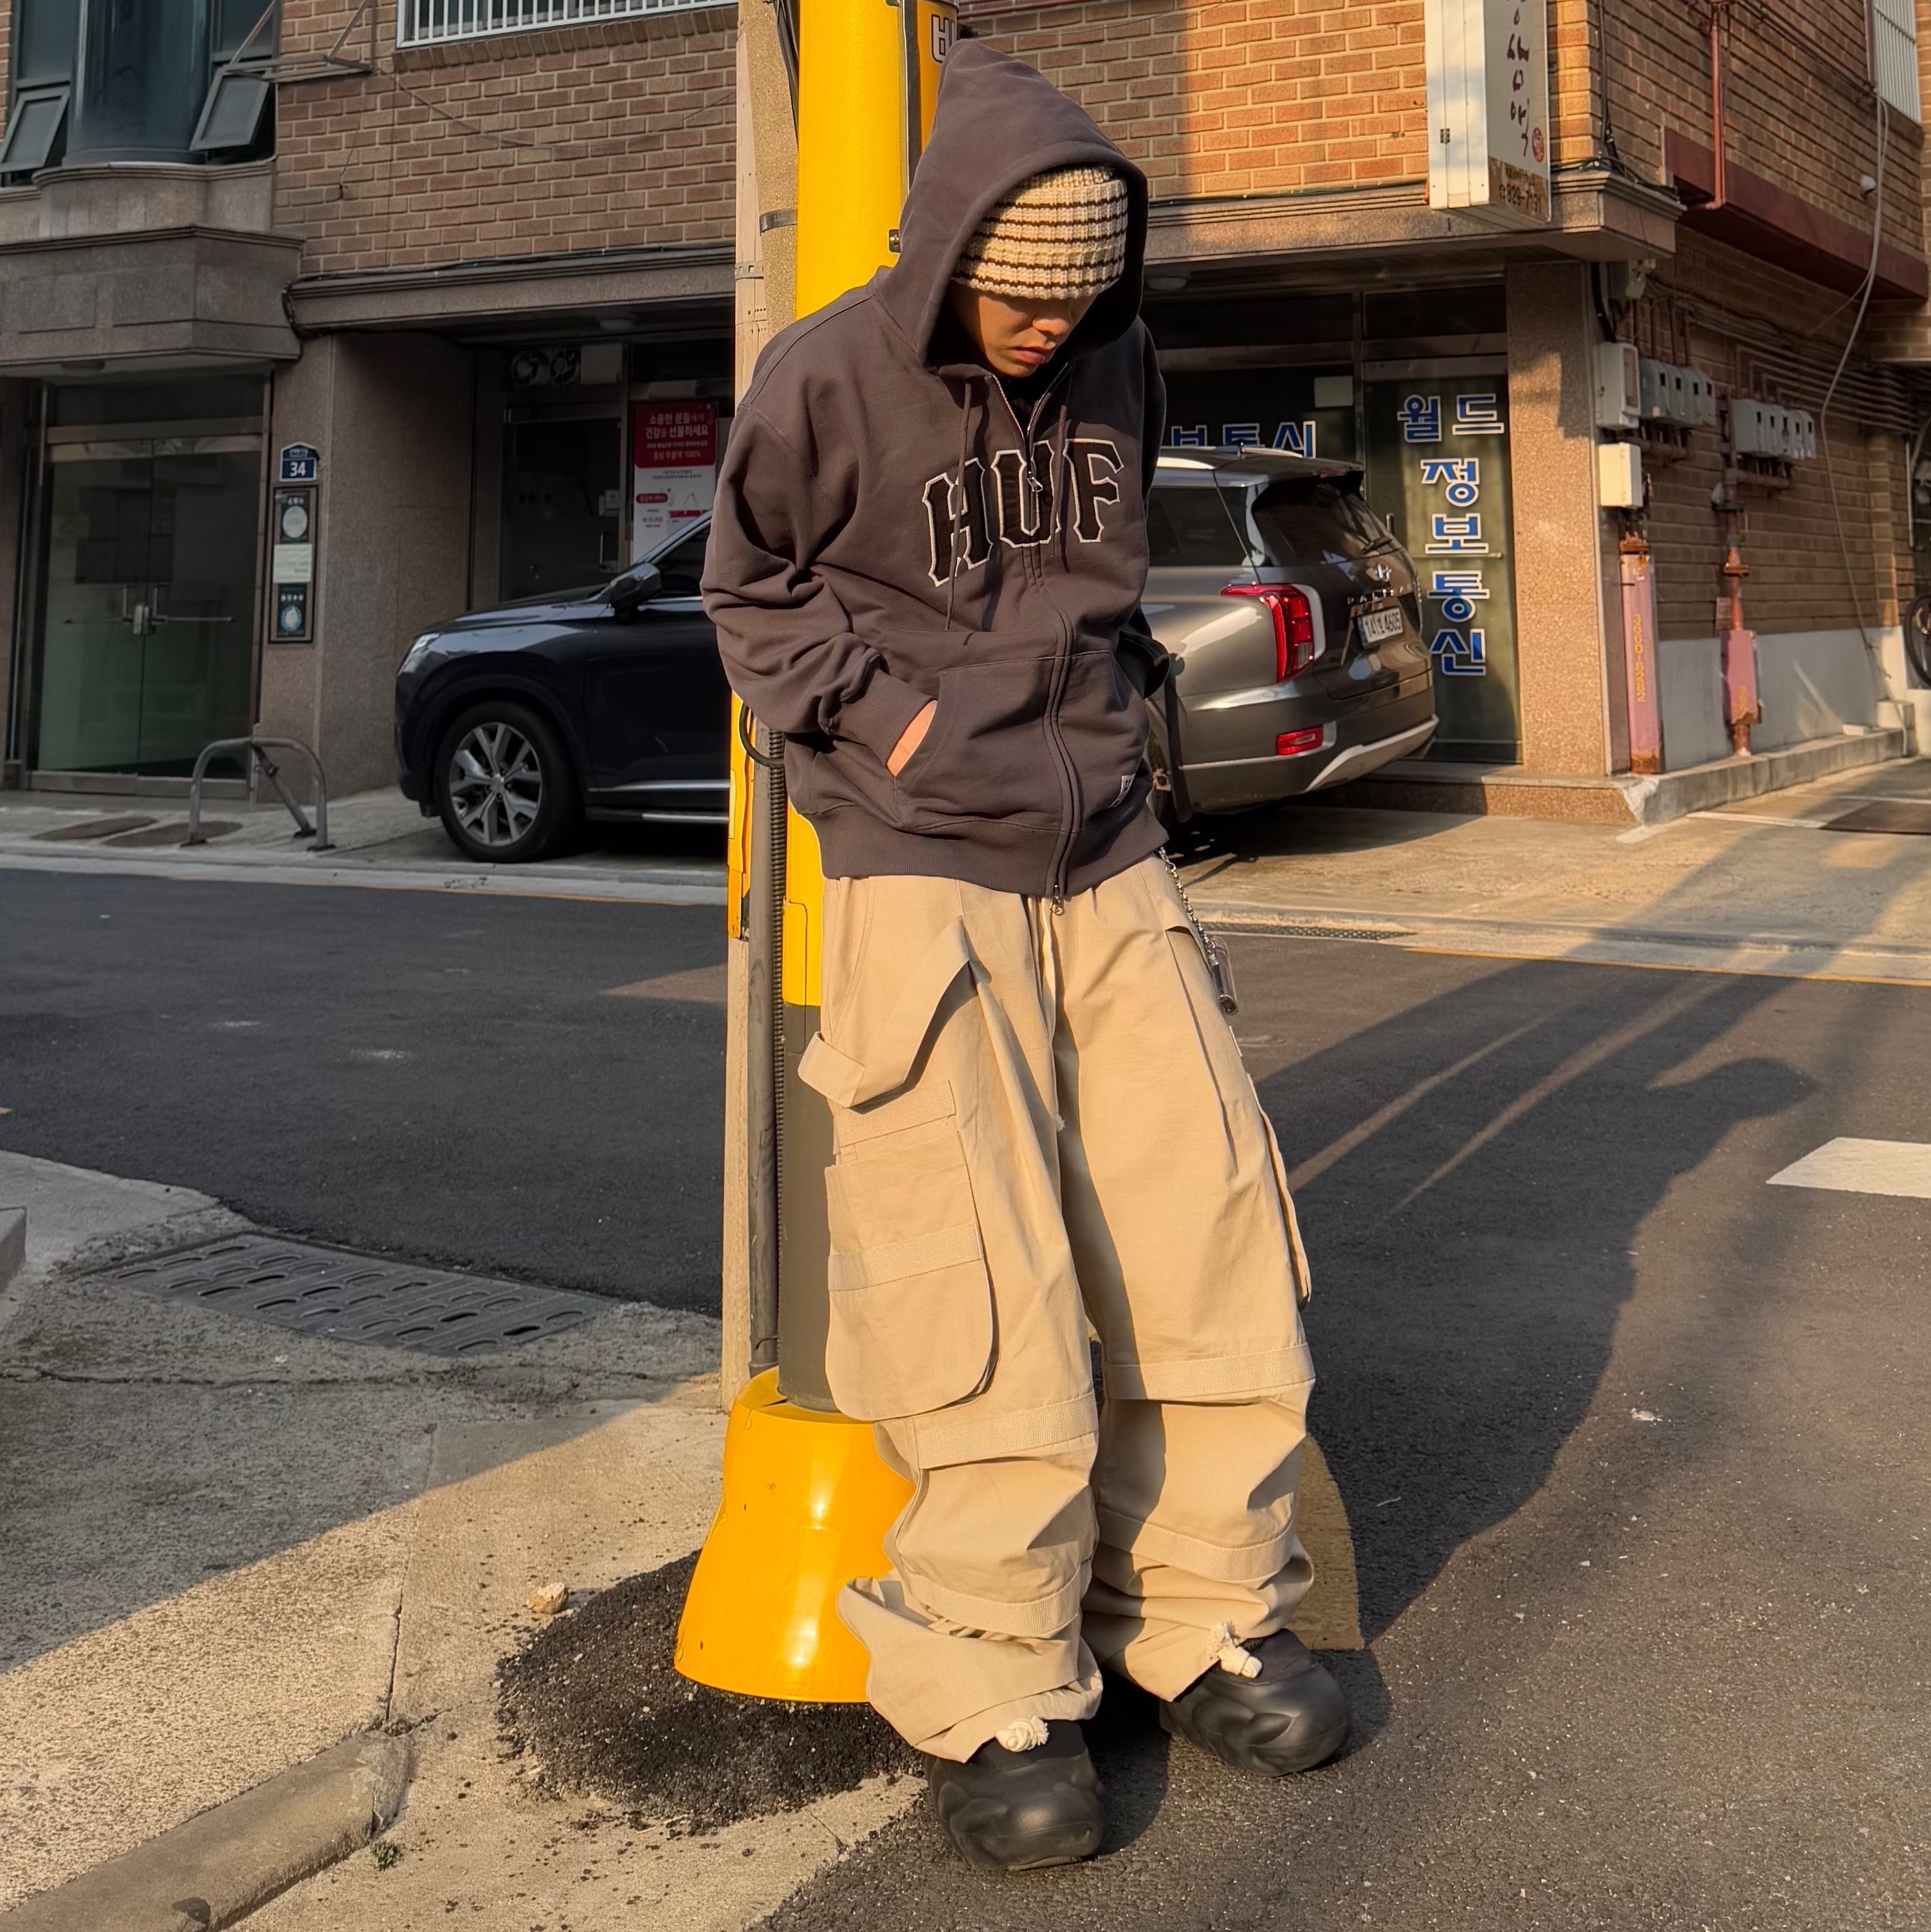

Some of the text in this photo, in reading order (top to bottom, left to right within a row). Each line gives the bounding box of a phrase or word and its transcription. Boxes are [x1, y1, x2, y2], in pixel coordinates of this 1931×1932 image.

[1397, 393, 1505, 443] 월드
[289, 461, 306, 477] 34
[922, 438, 1124, 588] HUF
[1420, 457, 1490, 676] 정보통신
